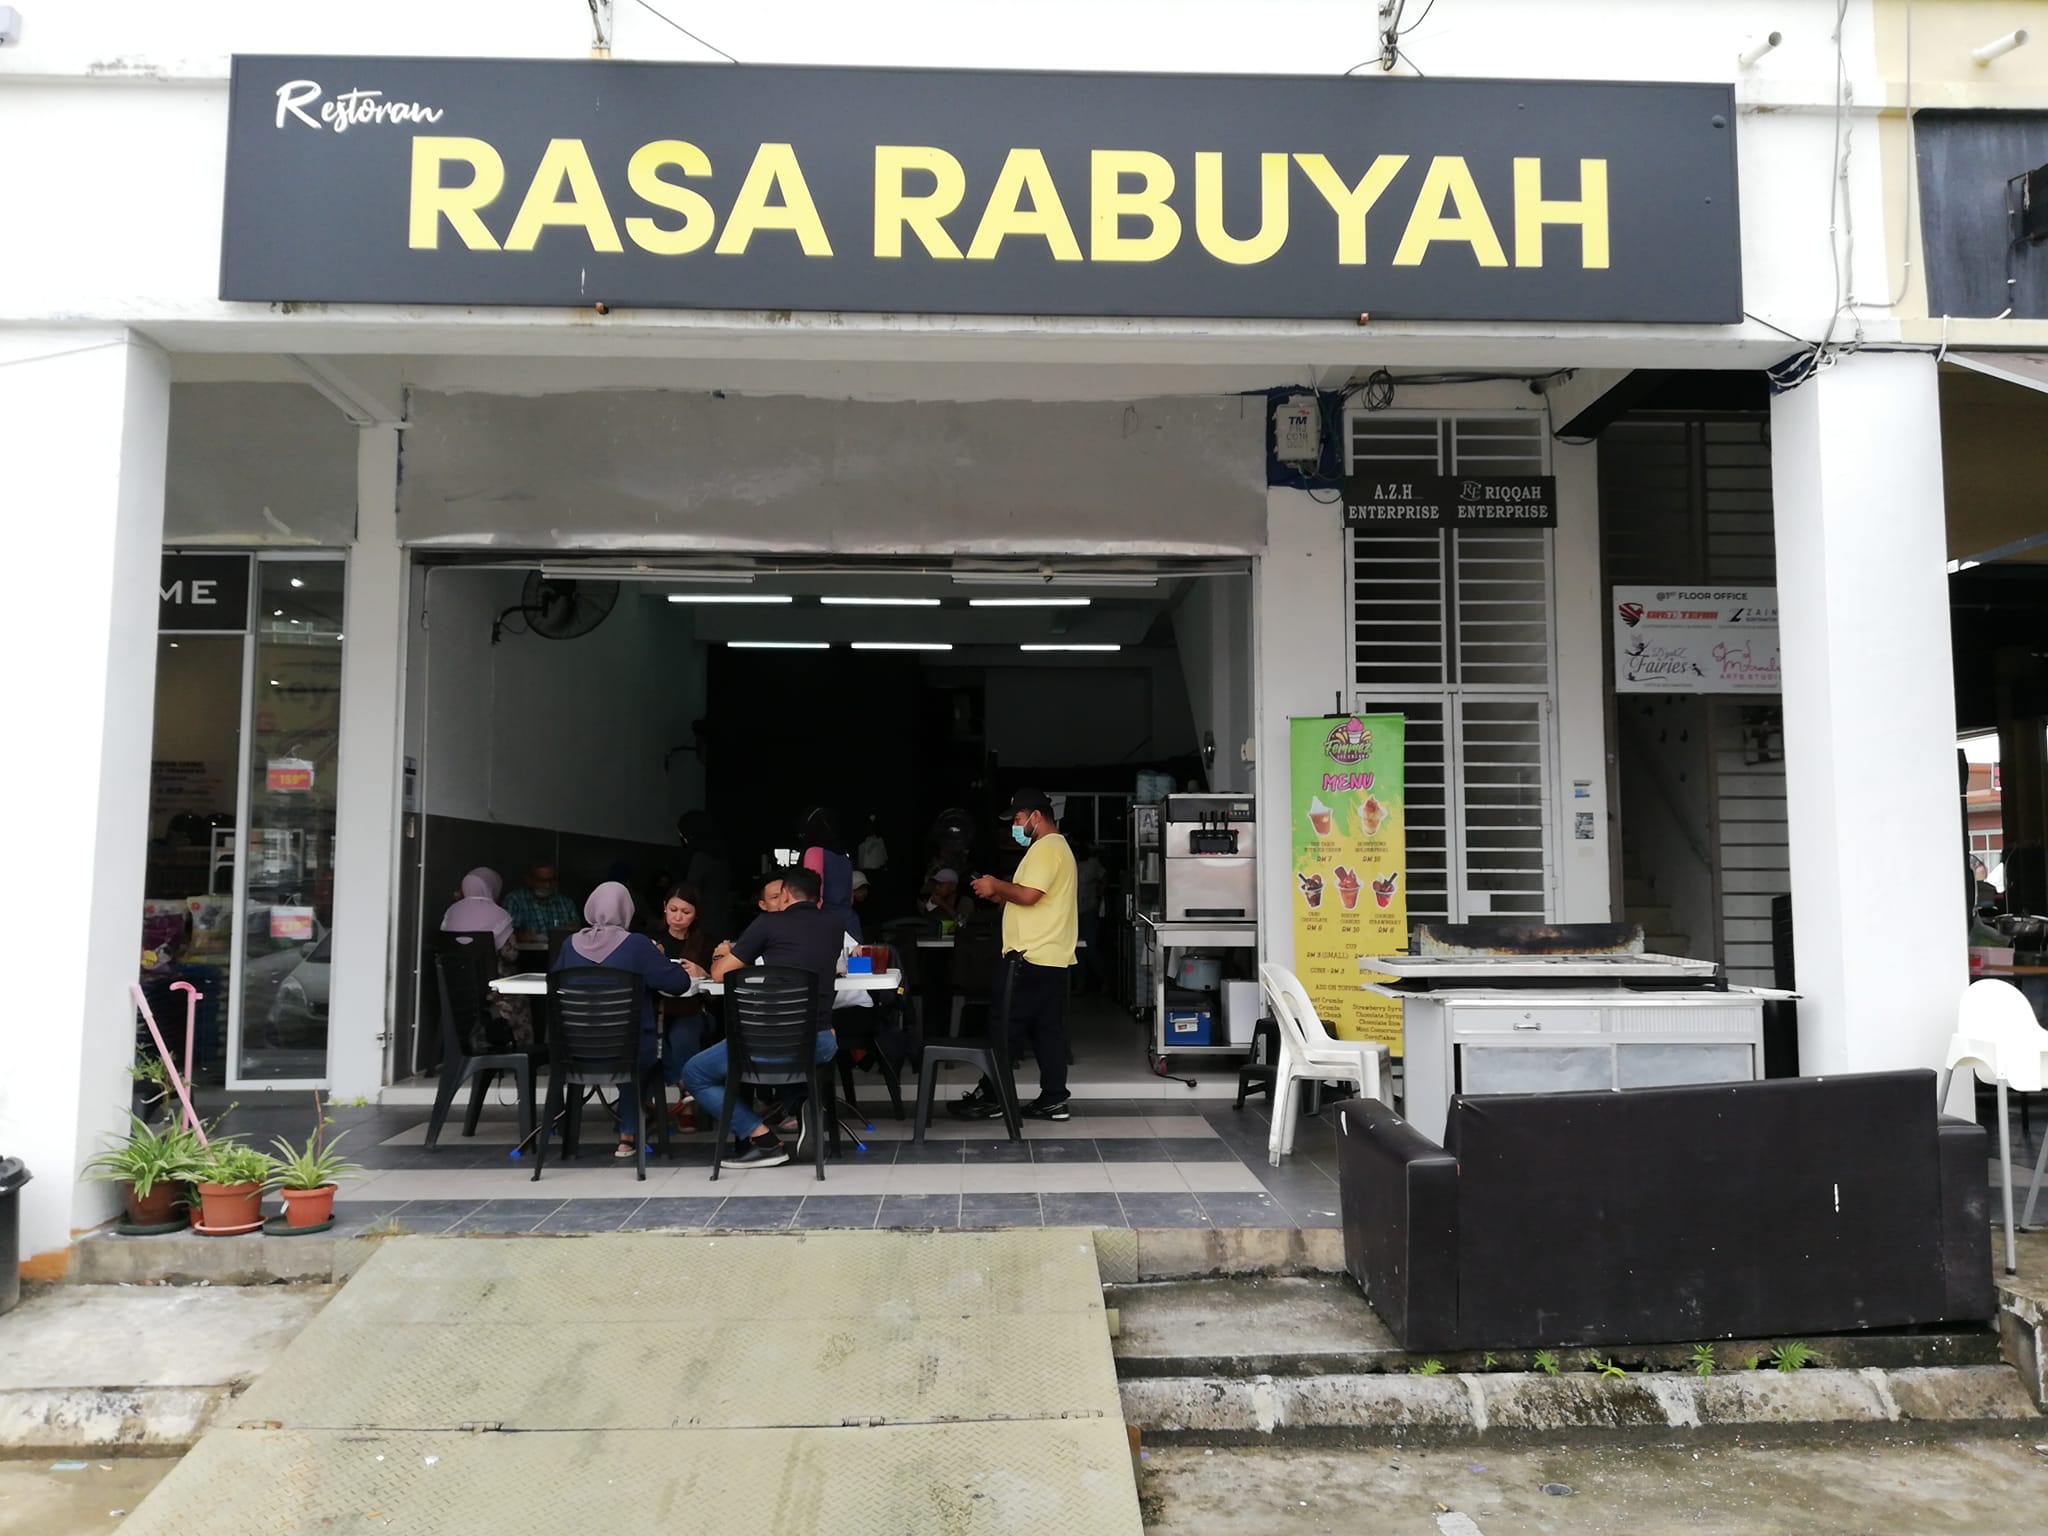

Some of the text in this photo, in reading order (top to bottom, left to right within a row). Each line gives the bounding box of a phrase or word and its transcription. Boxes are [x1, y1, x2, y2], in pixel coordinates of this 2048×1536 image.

[275, 79, 444, 134] Restoran
[408, 136, 1610, 269] RASA RABUYAH
[1288, 416, 1308, 425] TM
[1374, 484, 1413, 499] A.Z.H
[1485, 486, 1542, 500] RIQQAH
[1348, 505, 1440, 520] ENTERPRISE
[1457, 505, 1549, 519] ENTERPRISE
[1678, 592, 1711, 600] FLOOR
[1714, 592, 1748, 600] OFFICE
[1629, 654, 1688, 675] Fairies
[1322, 773, 1375, 791] MENU
